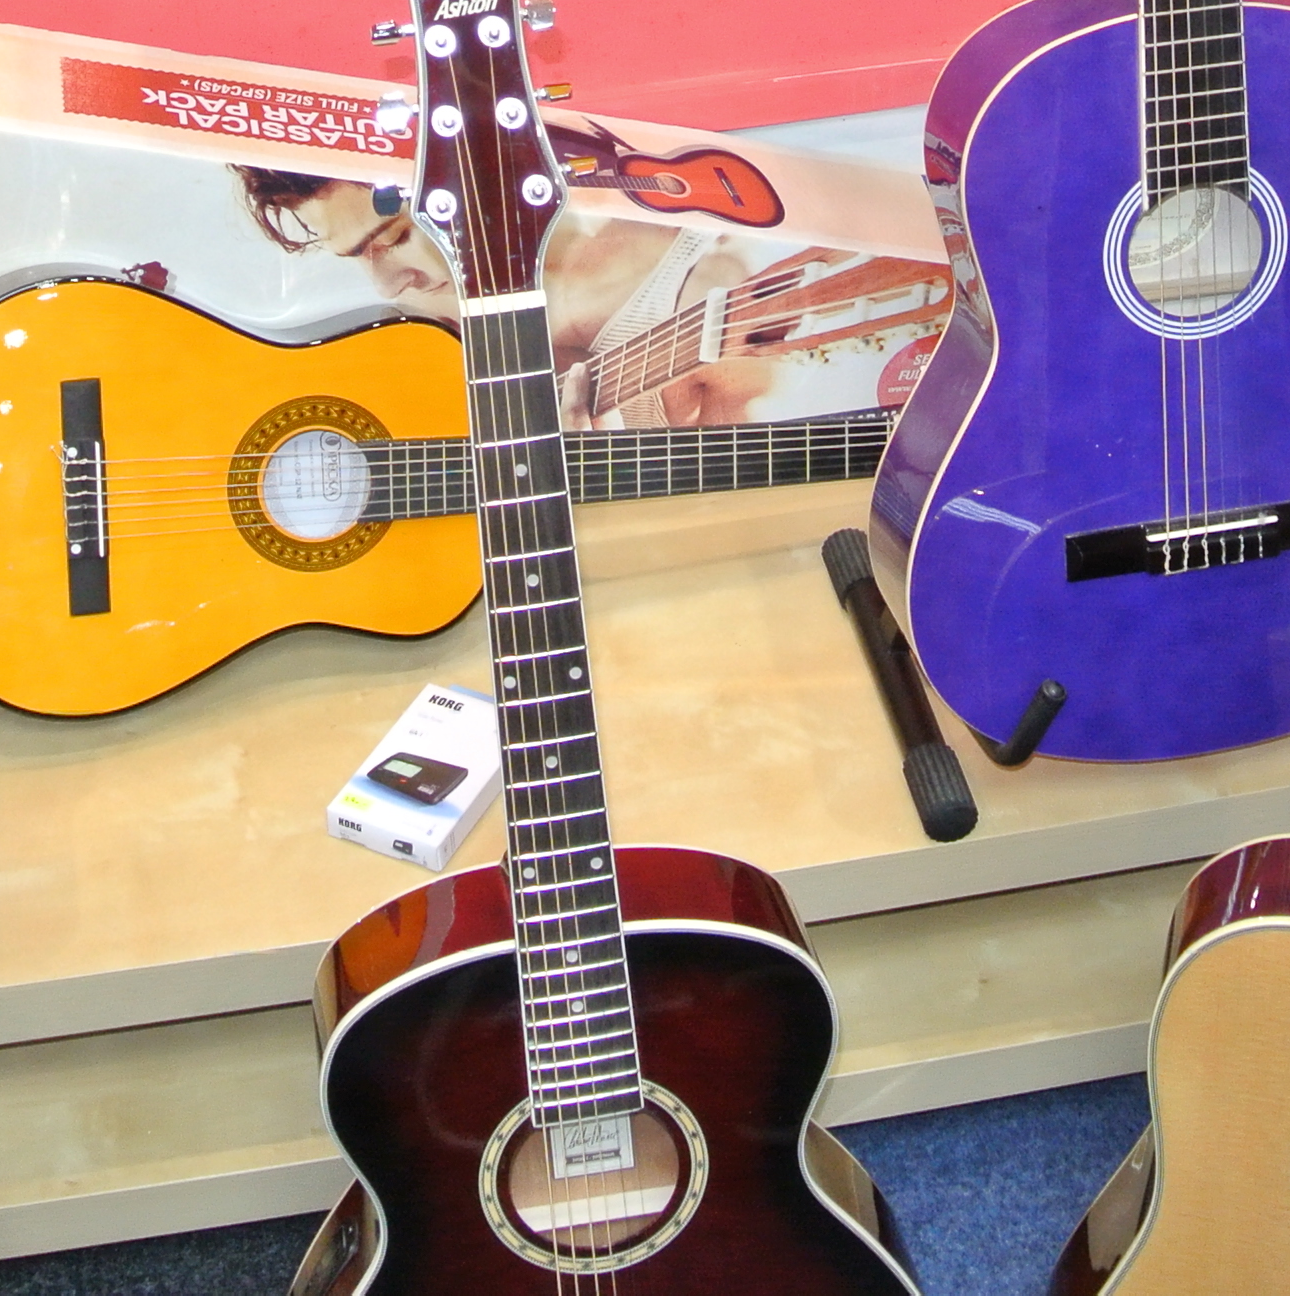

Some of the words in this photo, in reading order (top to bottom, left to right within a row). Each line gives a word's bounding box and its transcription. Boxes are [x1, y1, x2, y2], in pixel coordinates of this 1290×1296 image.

[193, 79, 272, 100] (SPC44S)
[140, 87, 248, 118] PACK
[275, 92, 314, 106] SIZE
[318, 97, 359, 113] FULL
[165, 107, 395, 154] CLASSICAL
[428, 694, 465, 712] KORG
[338, 817, 362, 832] KORG
